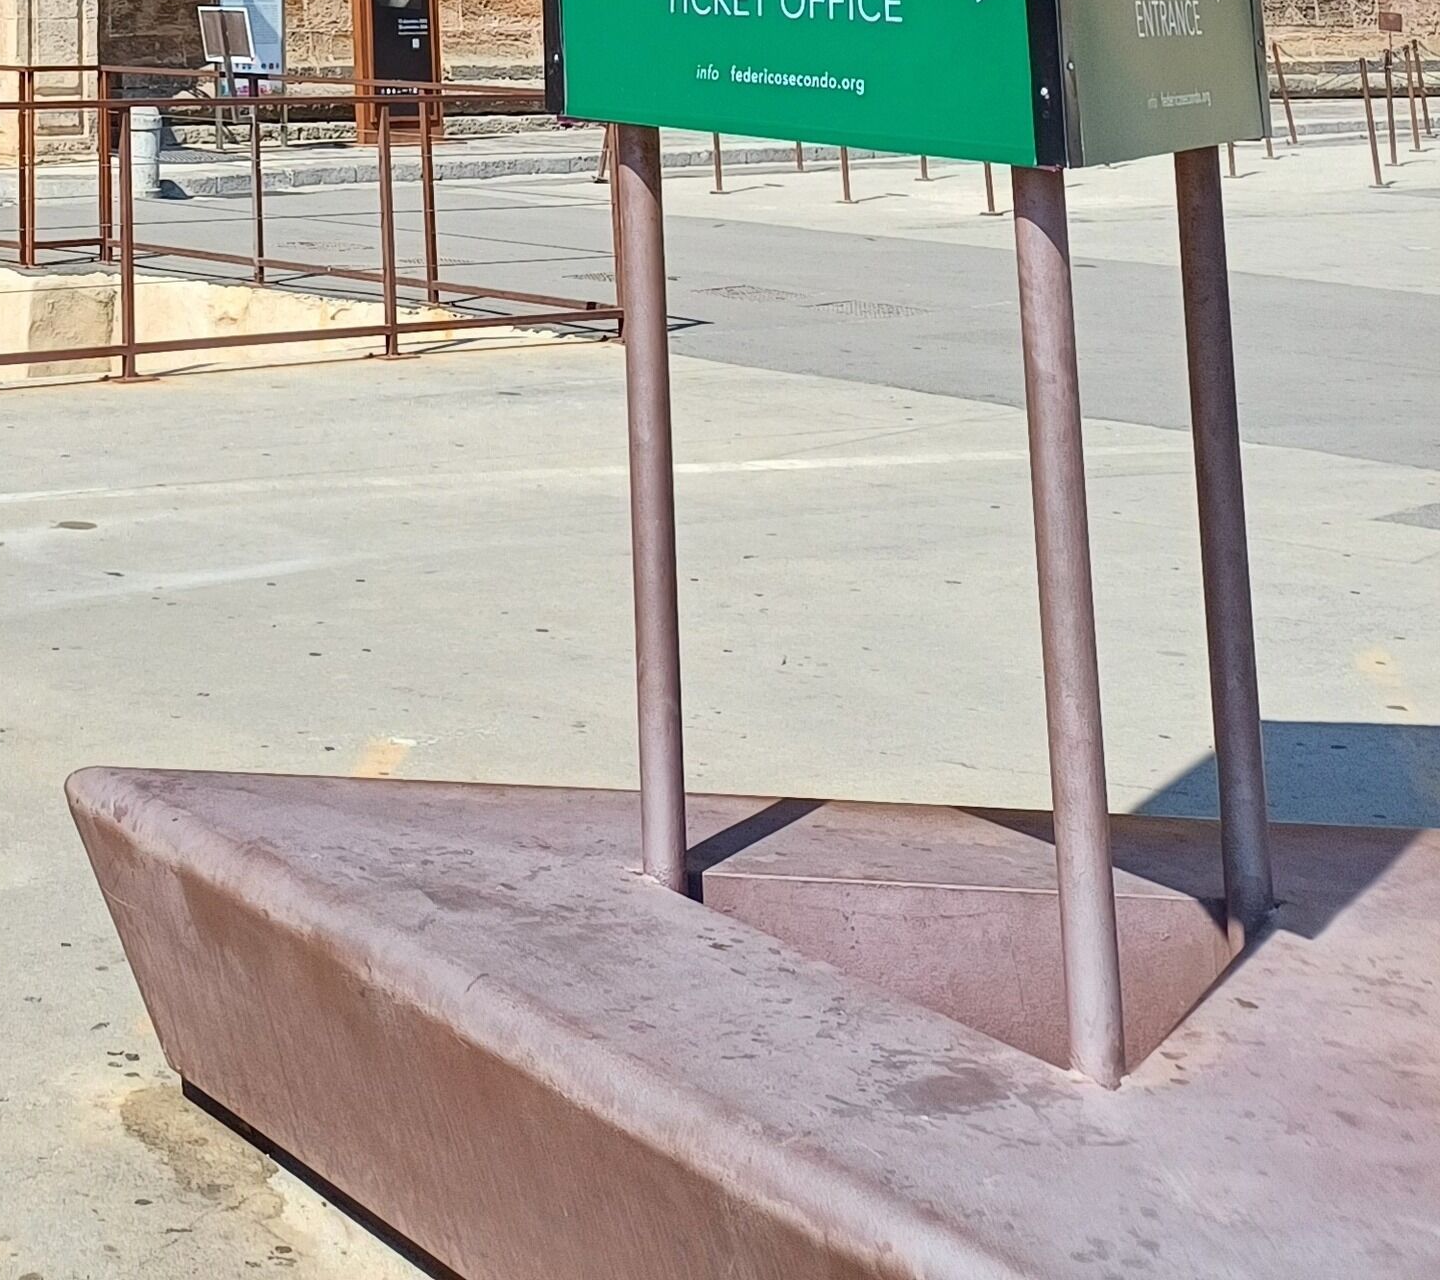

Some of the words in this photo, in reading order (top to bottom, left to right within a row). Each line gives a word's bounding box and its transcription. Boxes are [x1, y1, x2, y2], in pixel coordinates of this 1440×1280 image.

[1135, 0, 1202, 37] ENTRANCE
[697, 64, 719, 80] info
[731, 65, 864, 95] federicosecondo.org
